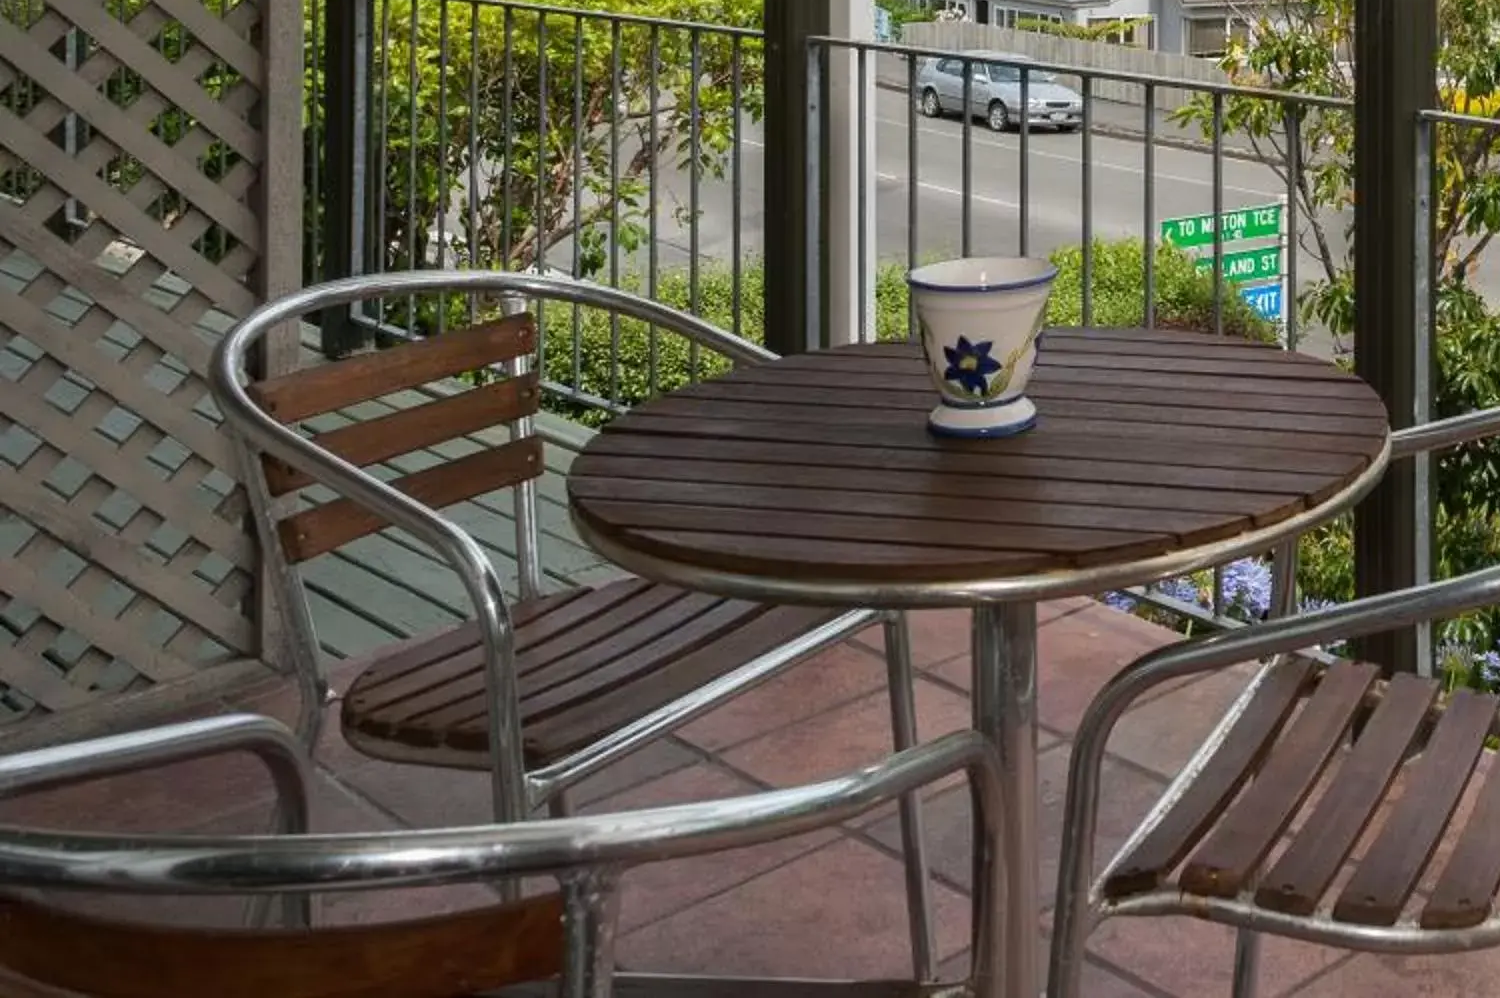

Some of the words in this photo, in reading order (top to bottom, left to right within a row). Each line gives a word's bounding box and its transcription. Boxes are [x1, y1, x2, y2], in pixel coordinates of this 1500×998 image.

[1178, 221, 1195, 237] TO
[1201, 212, 1247, 234] MITON
[1253, 209, 1276, 226] TCE
[1261, 254, 1277, 271] ST
